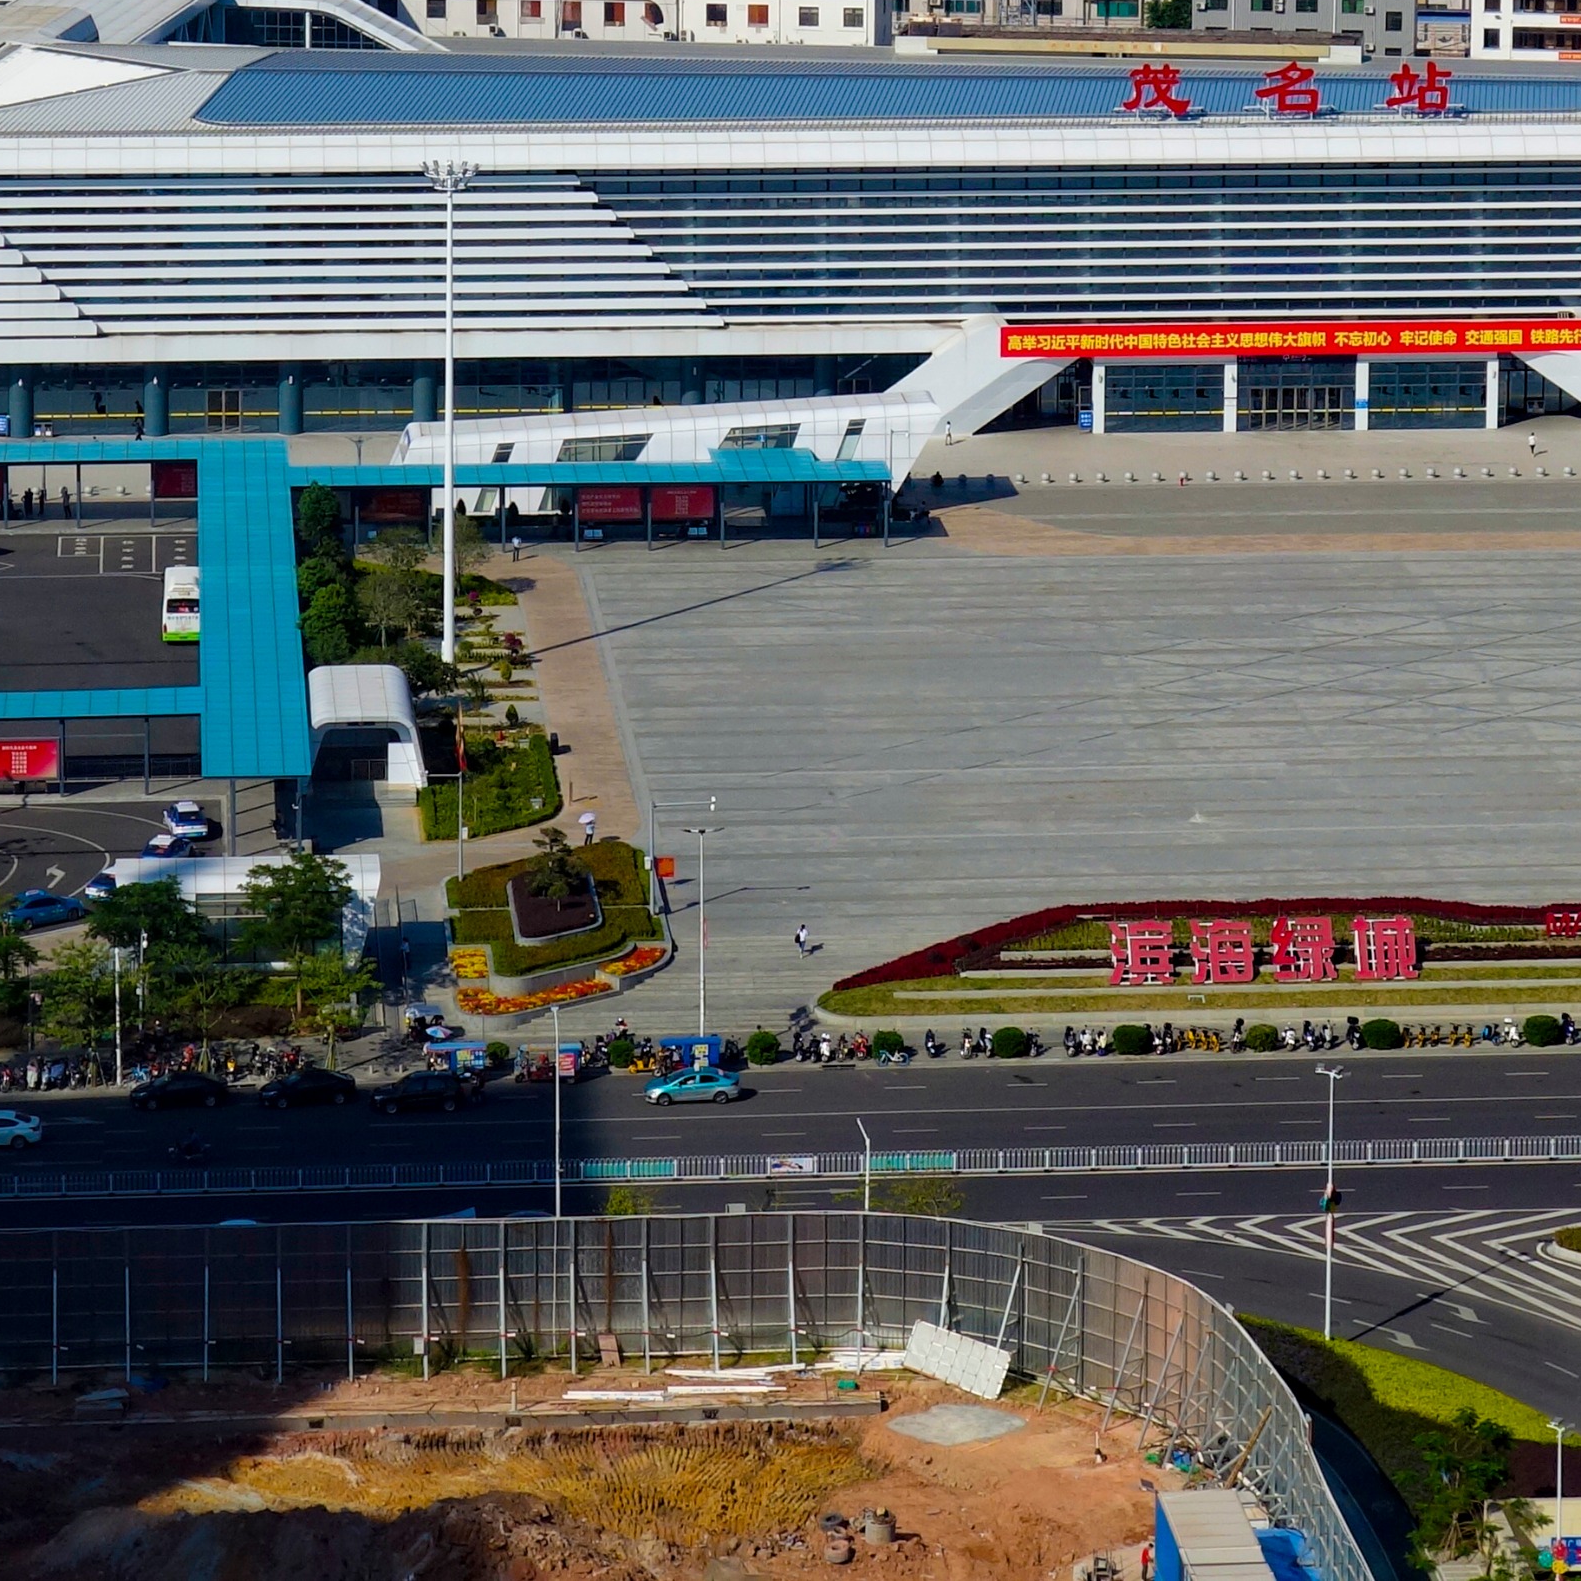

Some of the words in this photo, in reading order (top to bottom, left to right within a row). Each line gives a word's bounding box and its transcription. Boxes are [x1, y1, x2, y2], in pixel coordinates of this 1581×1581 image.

[1123, 61, 1453, 116] 茂名站
[1007, 331, 1326, 351] 高举习近平新时代中国特色社会主义思想伟大旗帜
[1333, 330, 1392, 347] 不忘初心
[1399, 330, 1458, 346] 牢记使命
[1464, 329, 1523, 346] 交通强国
[1108, 912, 1421, 986] 滨海绿城
